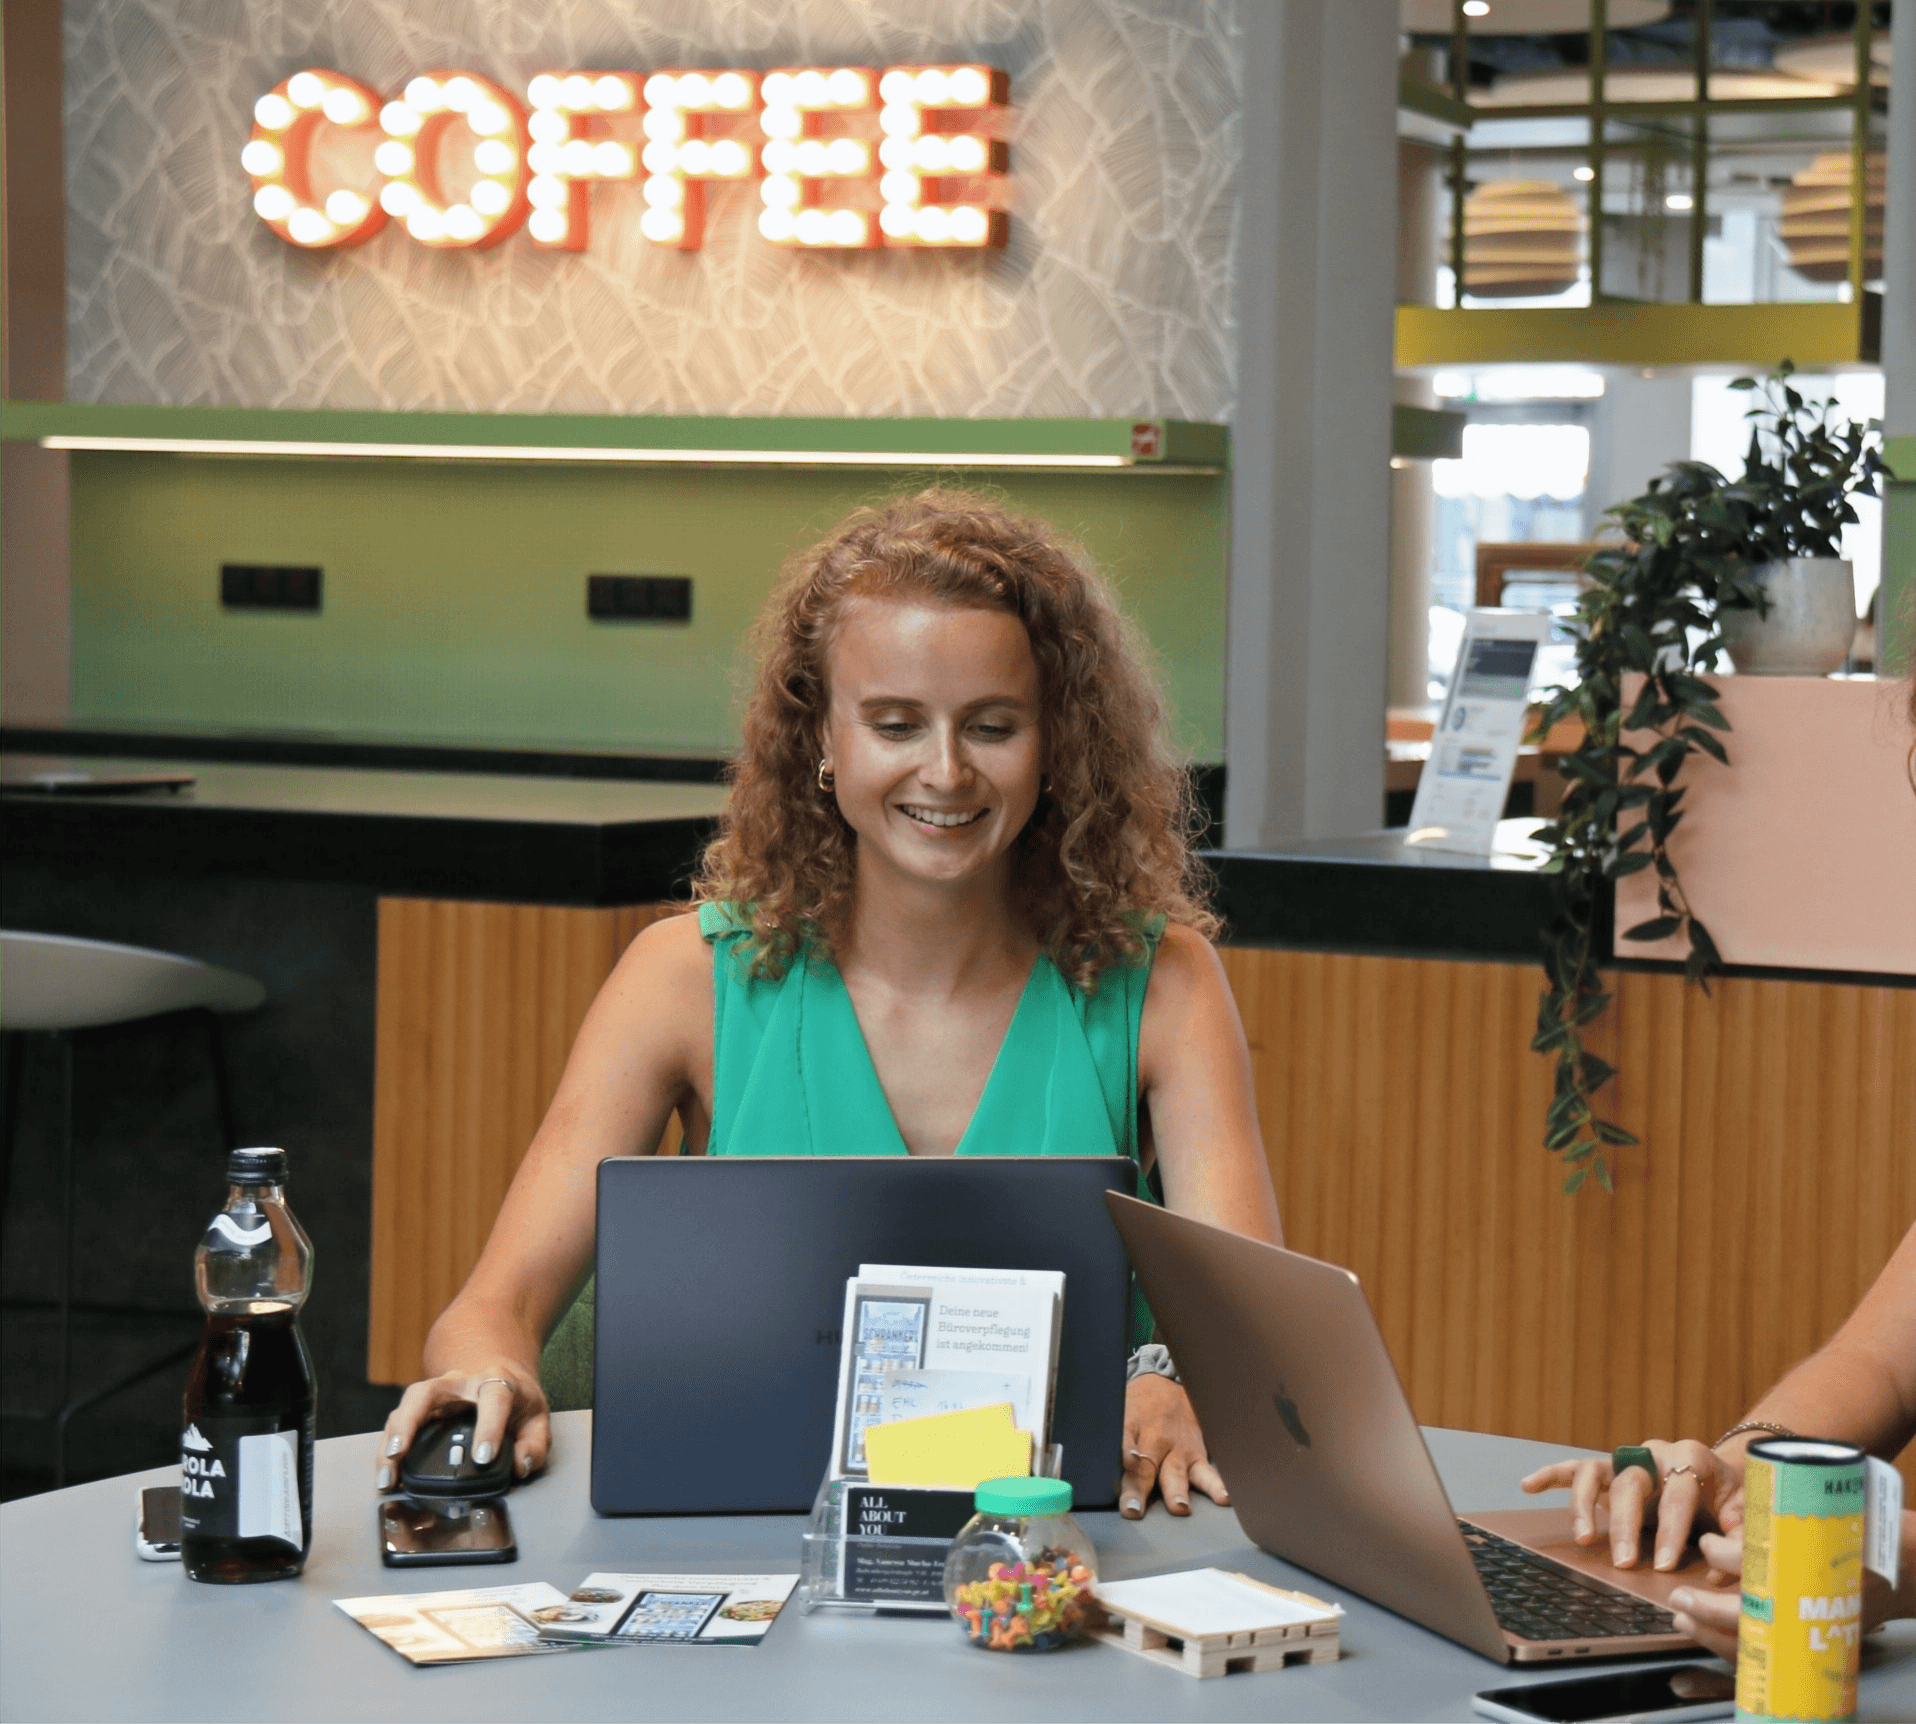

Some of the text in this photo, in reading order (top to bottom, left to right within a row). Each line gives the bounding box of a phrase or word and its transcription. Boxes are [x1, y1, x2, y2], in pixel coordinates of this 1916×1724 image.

[242, 66, 1005, 250] COFFEE
[939, 1305, 1000, 1318] Deine neue
[937, 1321, 1031, 1339] Büroverpflegung
[935, 1338, 950, 1349] ist
[859, 1496, 889, 1509] ALL
[859, 1510, 907, 1524] ABOUT
[858, 1523, 888, 1536] YOU
